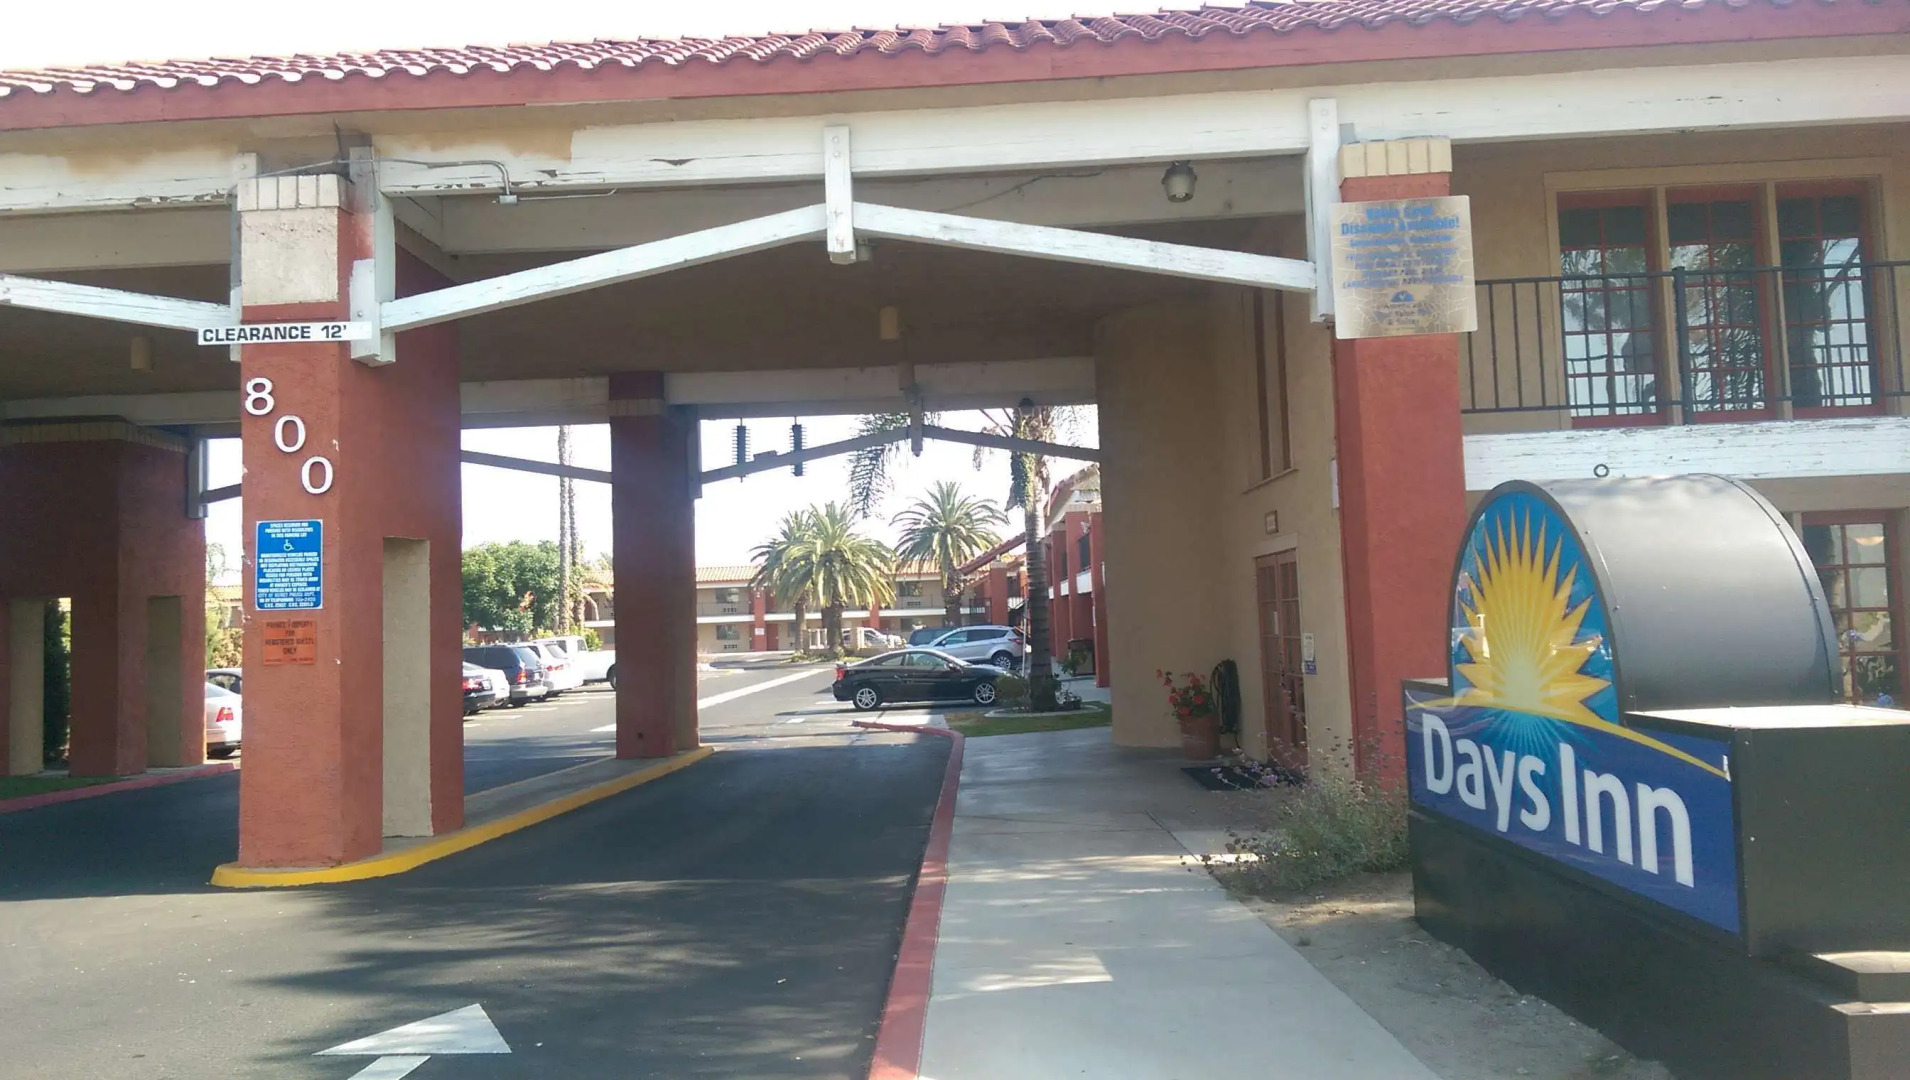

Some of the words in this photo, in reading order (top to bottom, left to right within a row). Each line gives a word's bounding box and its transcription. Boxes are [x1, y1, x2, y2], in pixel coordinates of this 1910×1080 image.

[203, 326, 311, 342] CLEARANCE
[321, 325, 347, 339] 12'
[1422, 713, 1551, 833] Days
[1559, 743, 1695, 888] Inn
